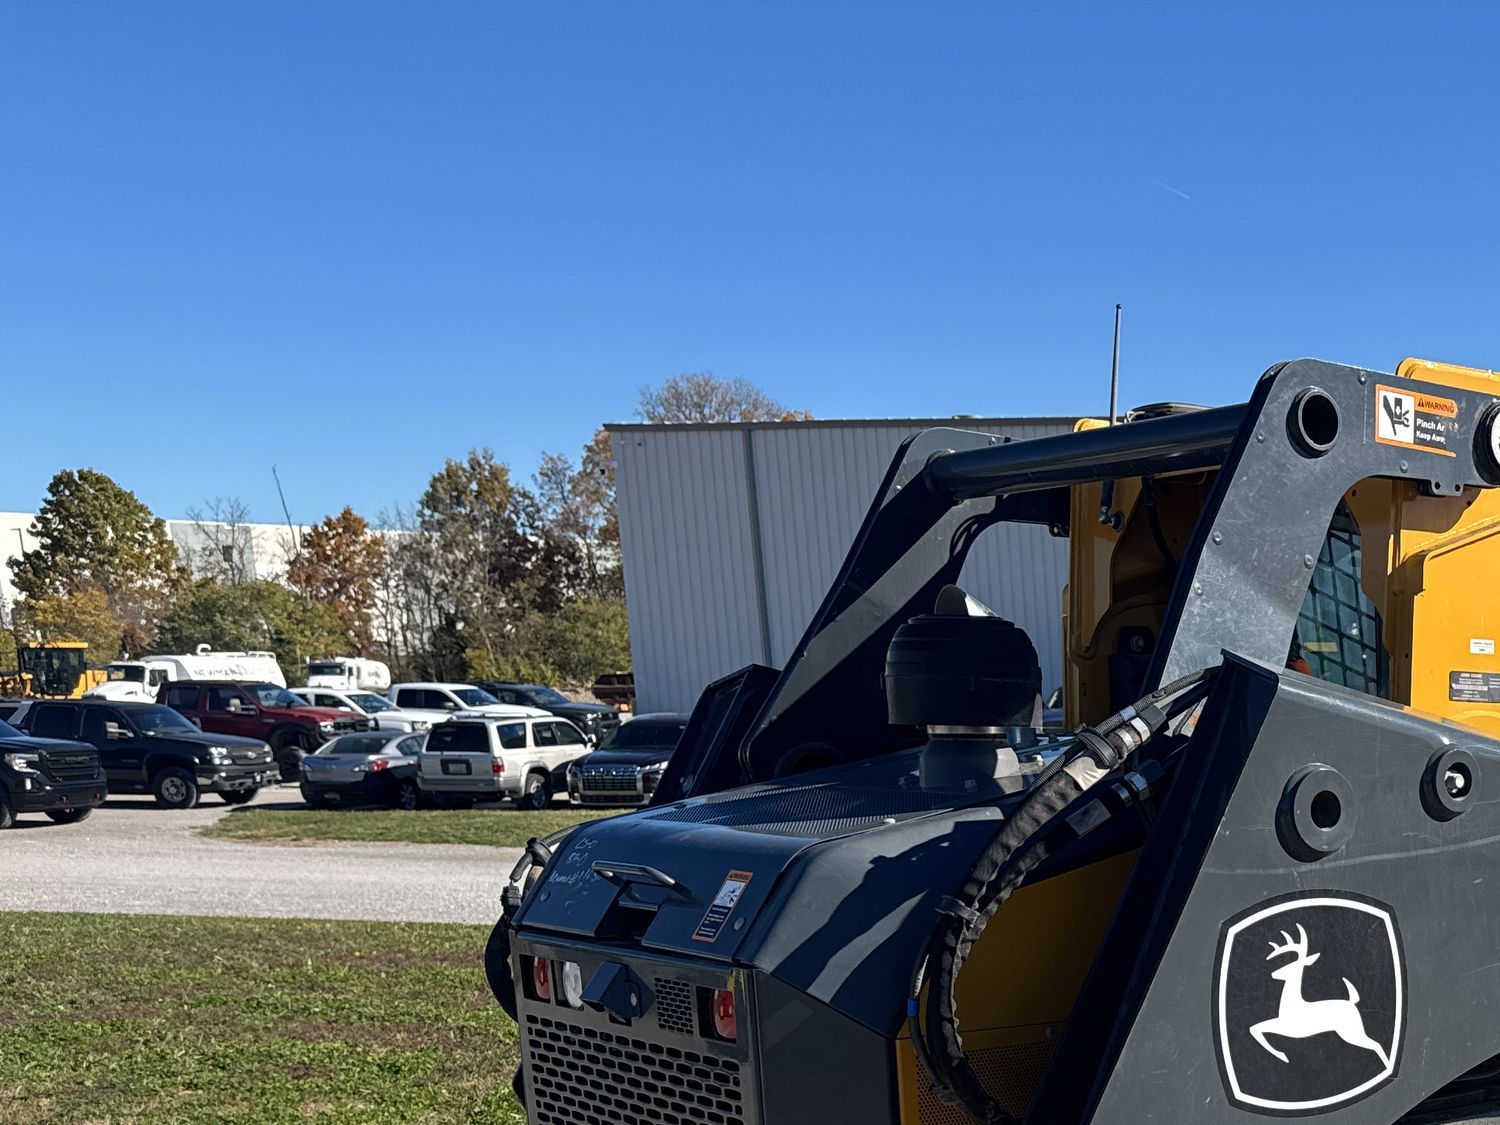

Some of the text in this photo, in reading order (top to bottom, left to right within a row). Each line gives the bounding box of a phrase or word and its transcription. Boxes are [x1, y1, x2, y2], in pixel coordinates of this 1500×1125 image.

[1424, 399, 1456, 414] WARNING
[1416, 418, 1436, 431] Pinch
[1416, 430, 1431, 442] Keep
